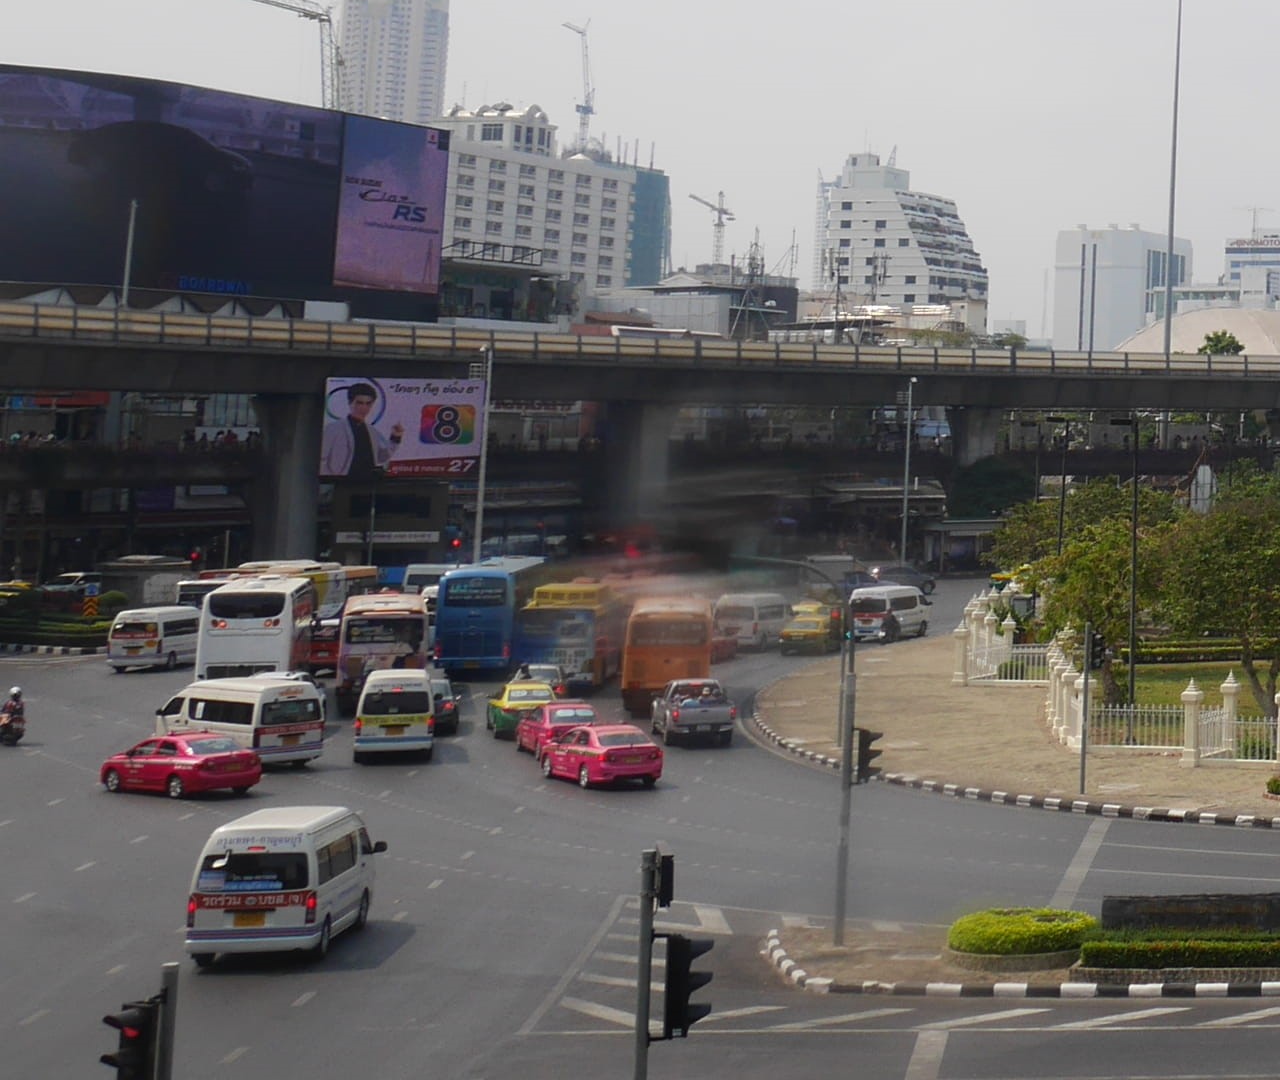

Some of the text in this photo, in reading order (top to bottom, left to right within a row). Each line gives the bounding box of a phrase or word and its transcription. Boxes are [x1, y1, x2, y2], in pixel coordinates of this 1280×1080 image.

[393, 205, 427, 223] RS
[434, 406, 461, 444] 8
[448, 460, 476, 472] 27
